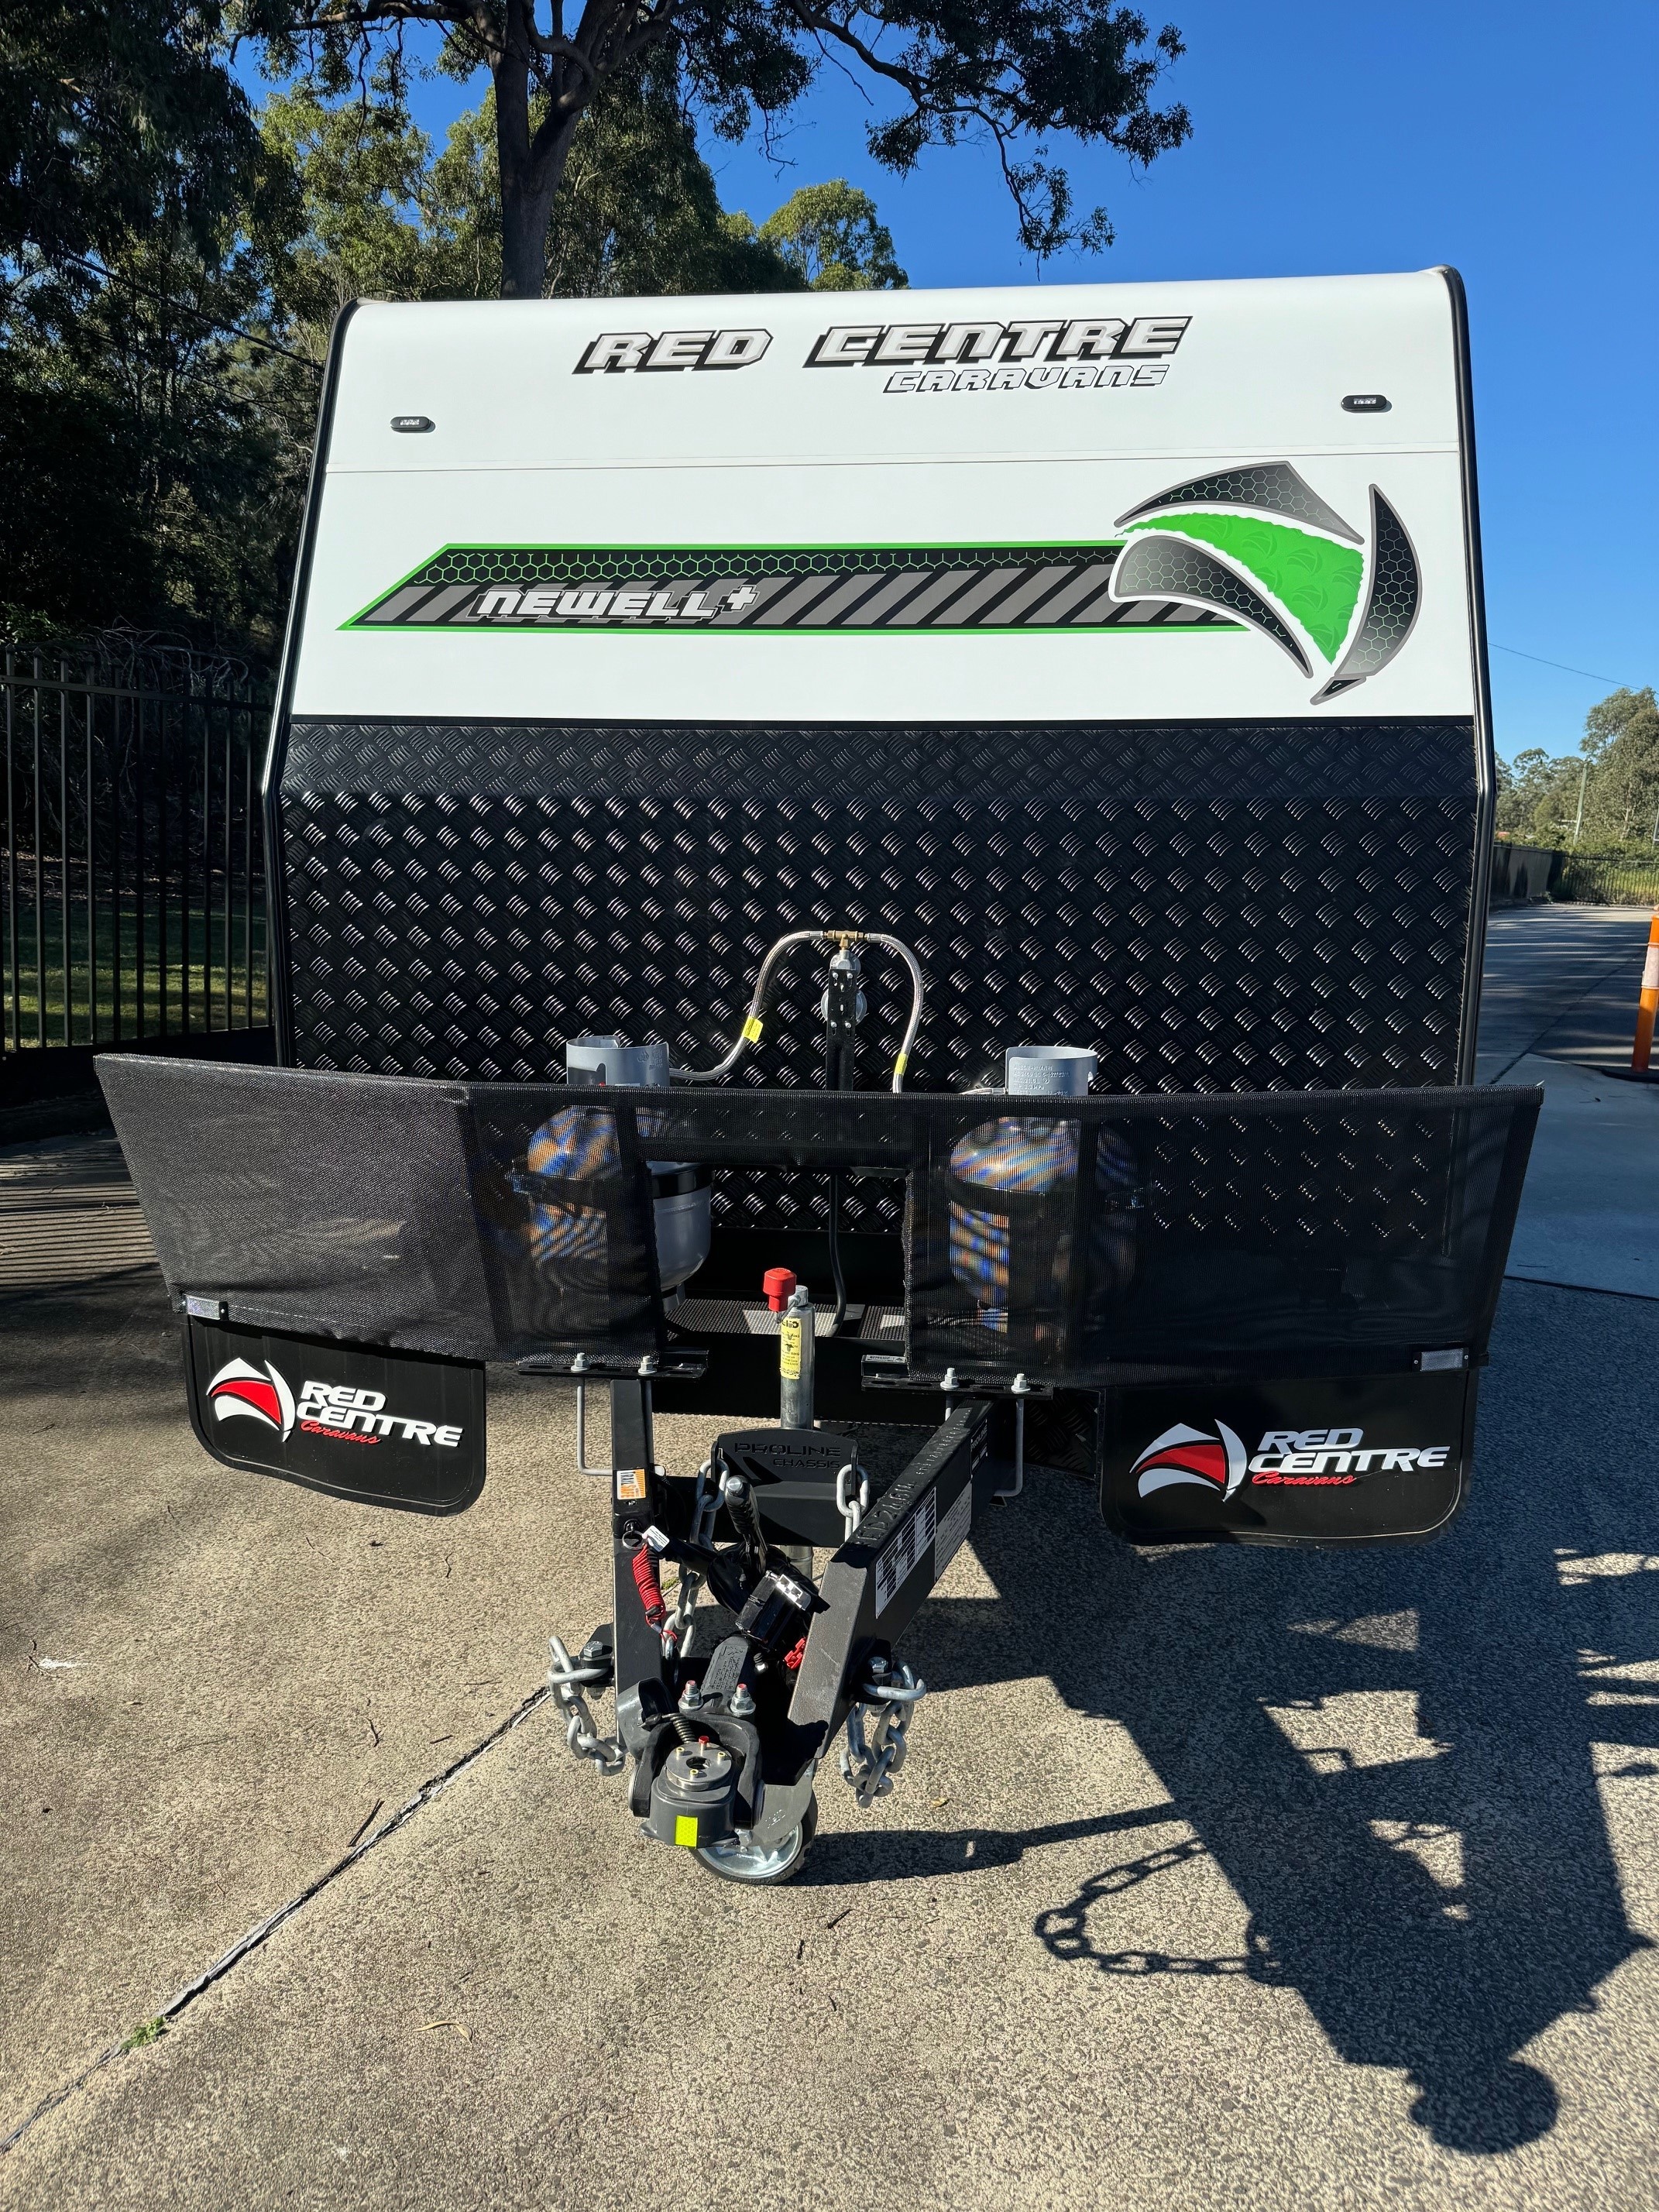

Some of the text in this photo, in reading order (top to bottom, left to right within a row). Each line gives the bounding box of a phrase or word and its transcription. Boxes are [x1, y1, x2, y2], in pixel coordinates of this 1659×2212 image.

[573, 315, 1193, 374] RED CENTRE
[883, 363, 1169, 393] CARAVANS
[301, 1380, 386, 1413] RED
[296, 1402, 463, 1448] CENTRE
[301, 1419, 383, 1445] Caravans
[734, 1443, 842, 1457] PROLINE
[1258, 1427, 1364, 1451] RED
[773, 1458, 841, 1469] CHASSIS
[1249, 1446, 1451, 1473] CENTRE
[1252, 1472, 1357, 1486] Caravans
